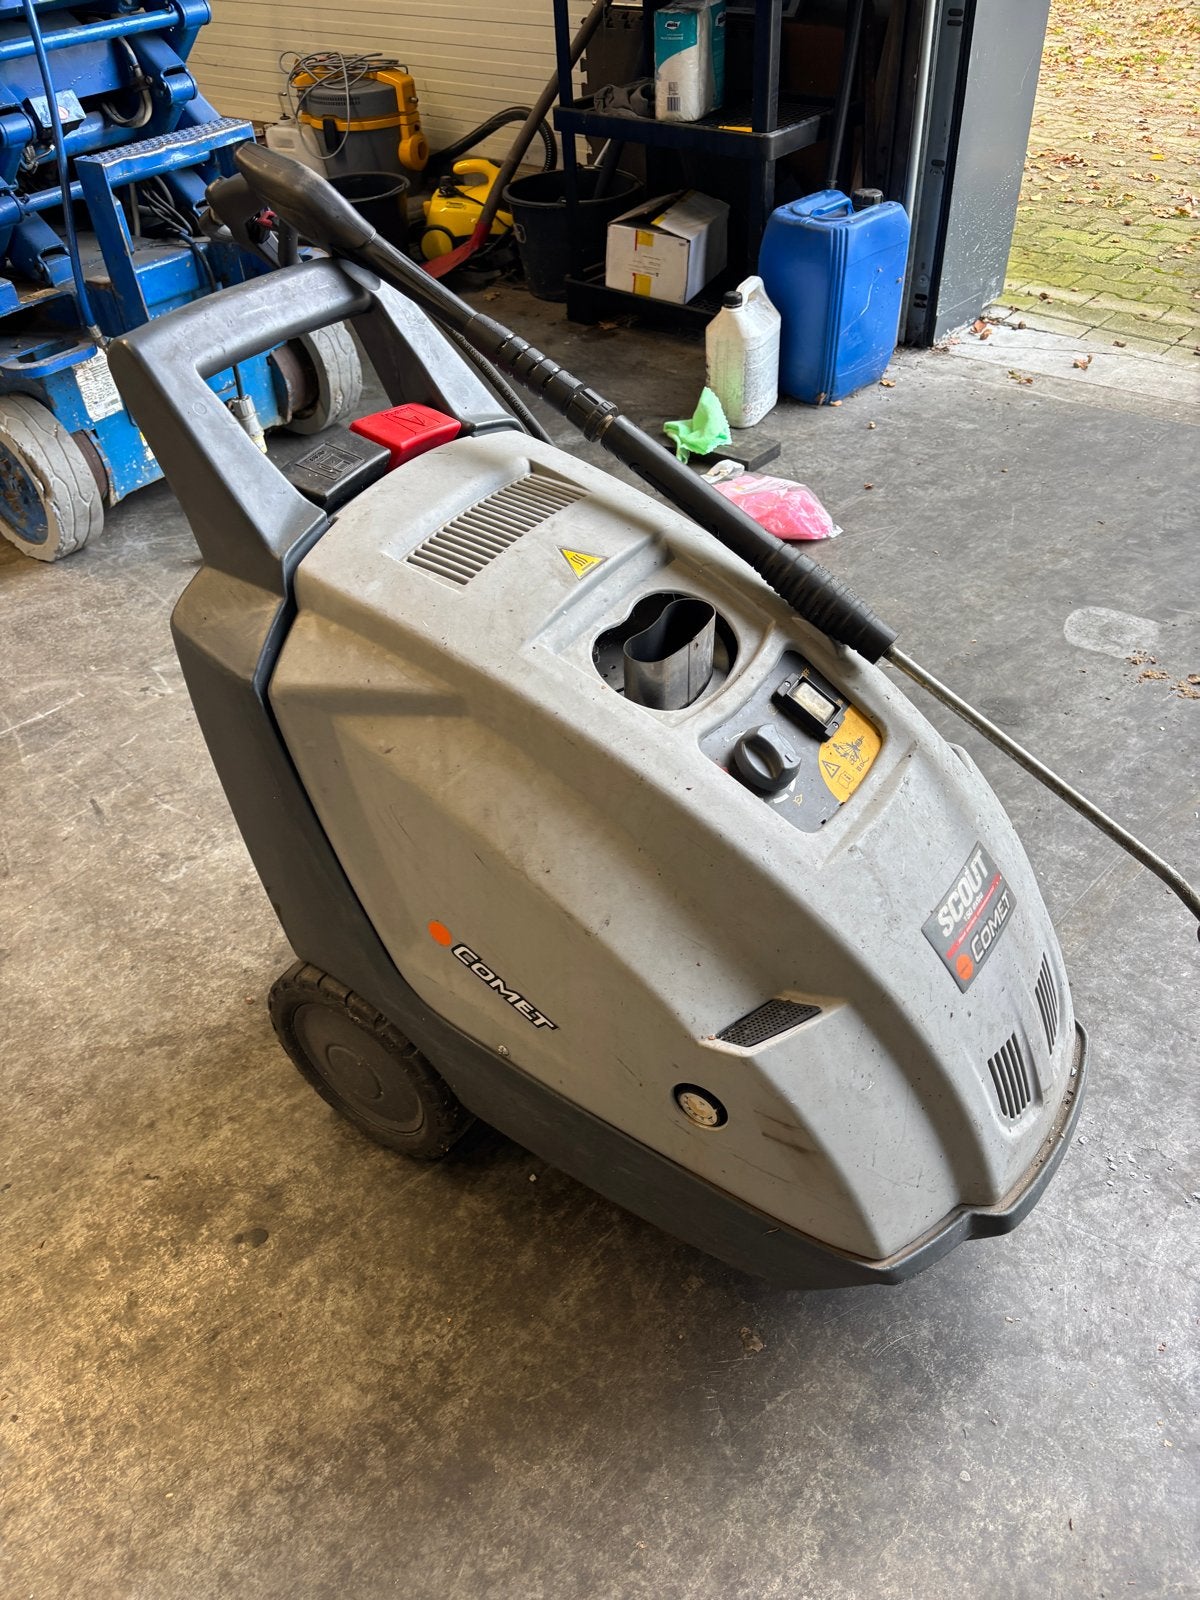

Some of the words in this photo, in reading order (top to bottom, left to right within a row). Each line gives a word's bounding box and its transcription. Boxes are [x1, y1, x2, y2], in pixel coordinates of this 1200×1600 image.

[937, 849, 988, 938] SCOUT
[970, 888, 1012, 964] COMET
[450, 943, 560, 1031] COMET
